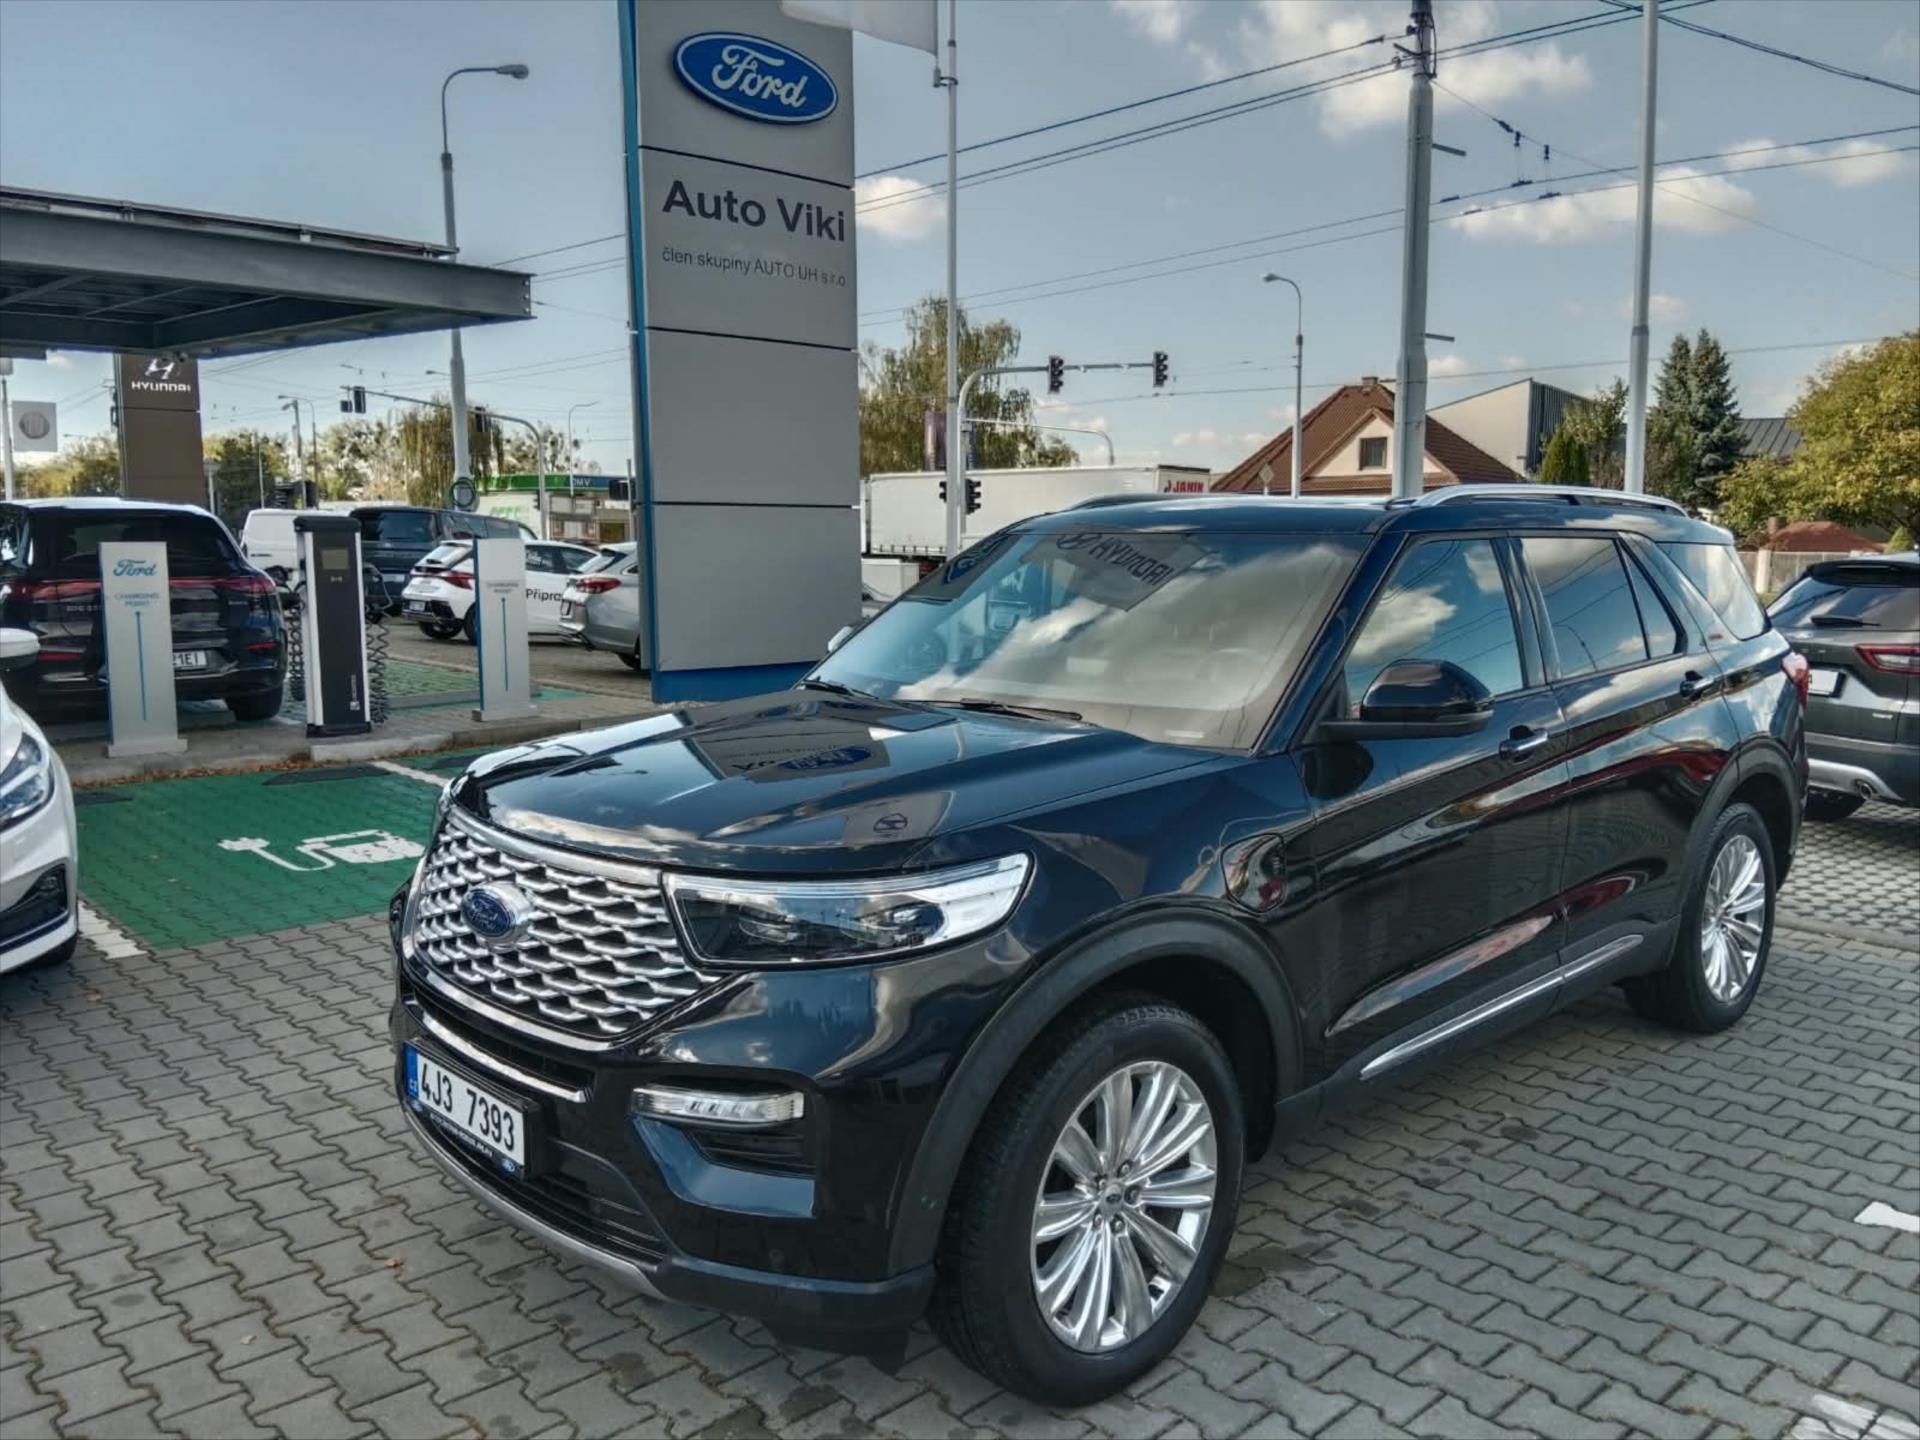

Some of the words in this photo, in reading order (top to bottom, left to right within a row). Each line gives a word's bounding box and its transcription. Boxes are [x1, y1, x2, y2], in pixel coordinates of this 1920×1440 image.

[711, 44, 808, 107] Ford
[662, 180, 766, 227] Auto
[776, 198, 845, 242] Viki
[662, 247, 692, 265] člen
[697, 251, 750, 275] skupiny
[754, 258, 794, 279] AUTO
[798, 264, 818, 282] UH
[131, 381, 191, 392] HYUNDAI
[113, 559, 157, 576] Ford
[421, 1063, 453, 1113] 4J3
[466, 1087, 515, 1152] 7393
